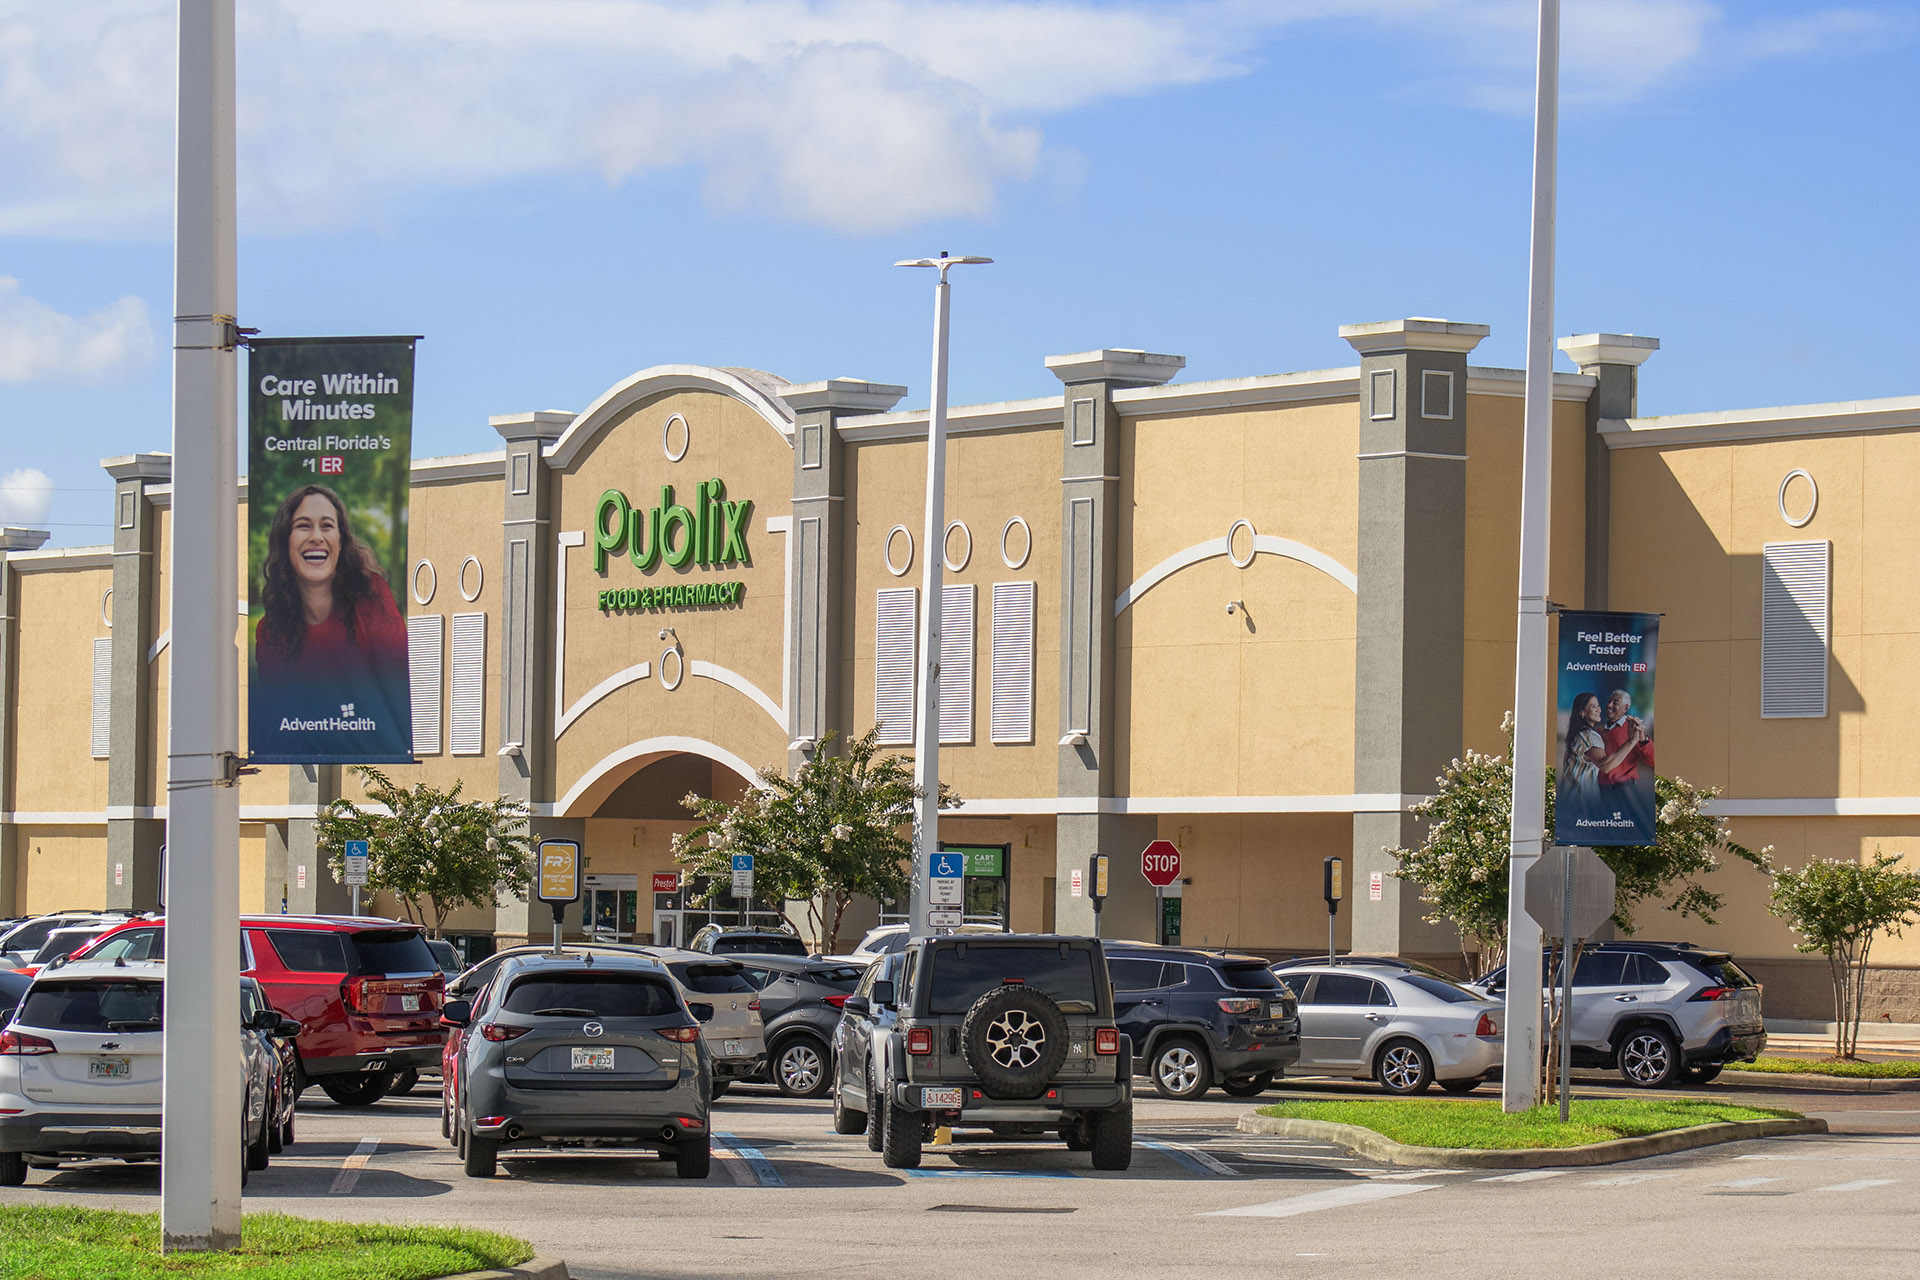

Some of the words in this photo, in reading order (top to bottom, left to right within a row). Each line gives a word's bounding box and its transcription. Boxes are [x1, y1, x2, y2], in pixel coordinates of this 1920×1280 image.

[260, 374, 317, 396] Care
[321, 372, 399, 395] Within
[281, 399, 376, 421] Minutes
[264, 436, 322, 451] Central
[325, 434, 391, 450] Florida's
[302, 457, 316, 473] #1
[321, 457, 343, 472] ER
[594, 477, 752, 573] Publix
[598, 588, 638, 611] FOOD
[640, 586, 652, 608] &
[653, 581, 745, 607] PHARMACY
[1577, 631, 1603, 642] Feel
[1605, 632, 1642, 643] Better
[1588, 644, 1627, 655] Faster
[1565, 661, 1631, 672] AdventHealth
[1633, 663, 1646, 672] ER
[279, 717, 376, 731] AdventHealth
[1575, 819, 1634, 828] AdventHealth
[1144, 854, 1179, 872] STOP
[653, 878, 676, 889] Presto!
